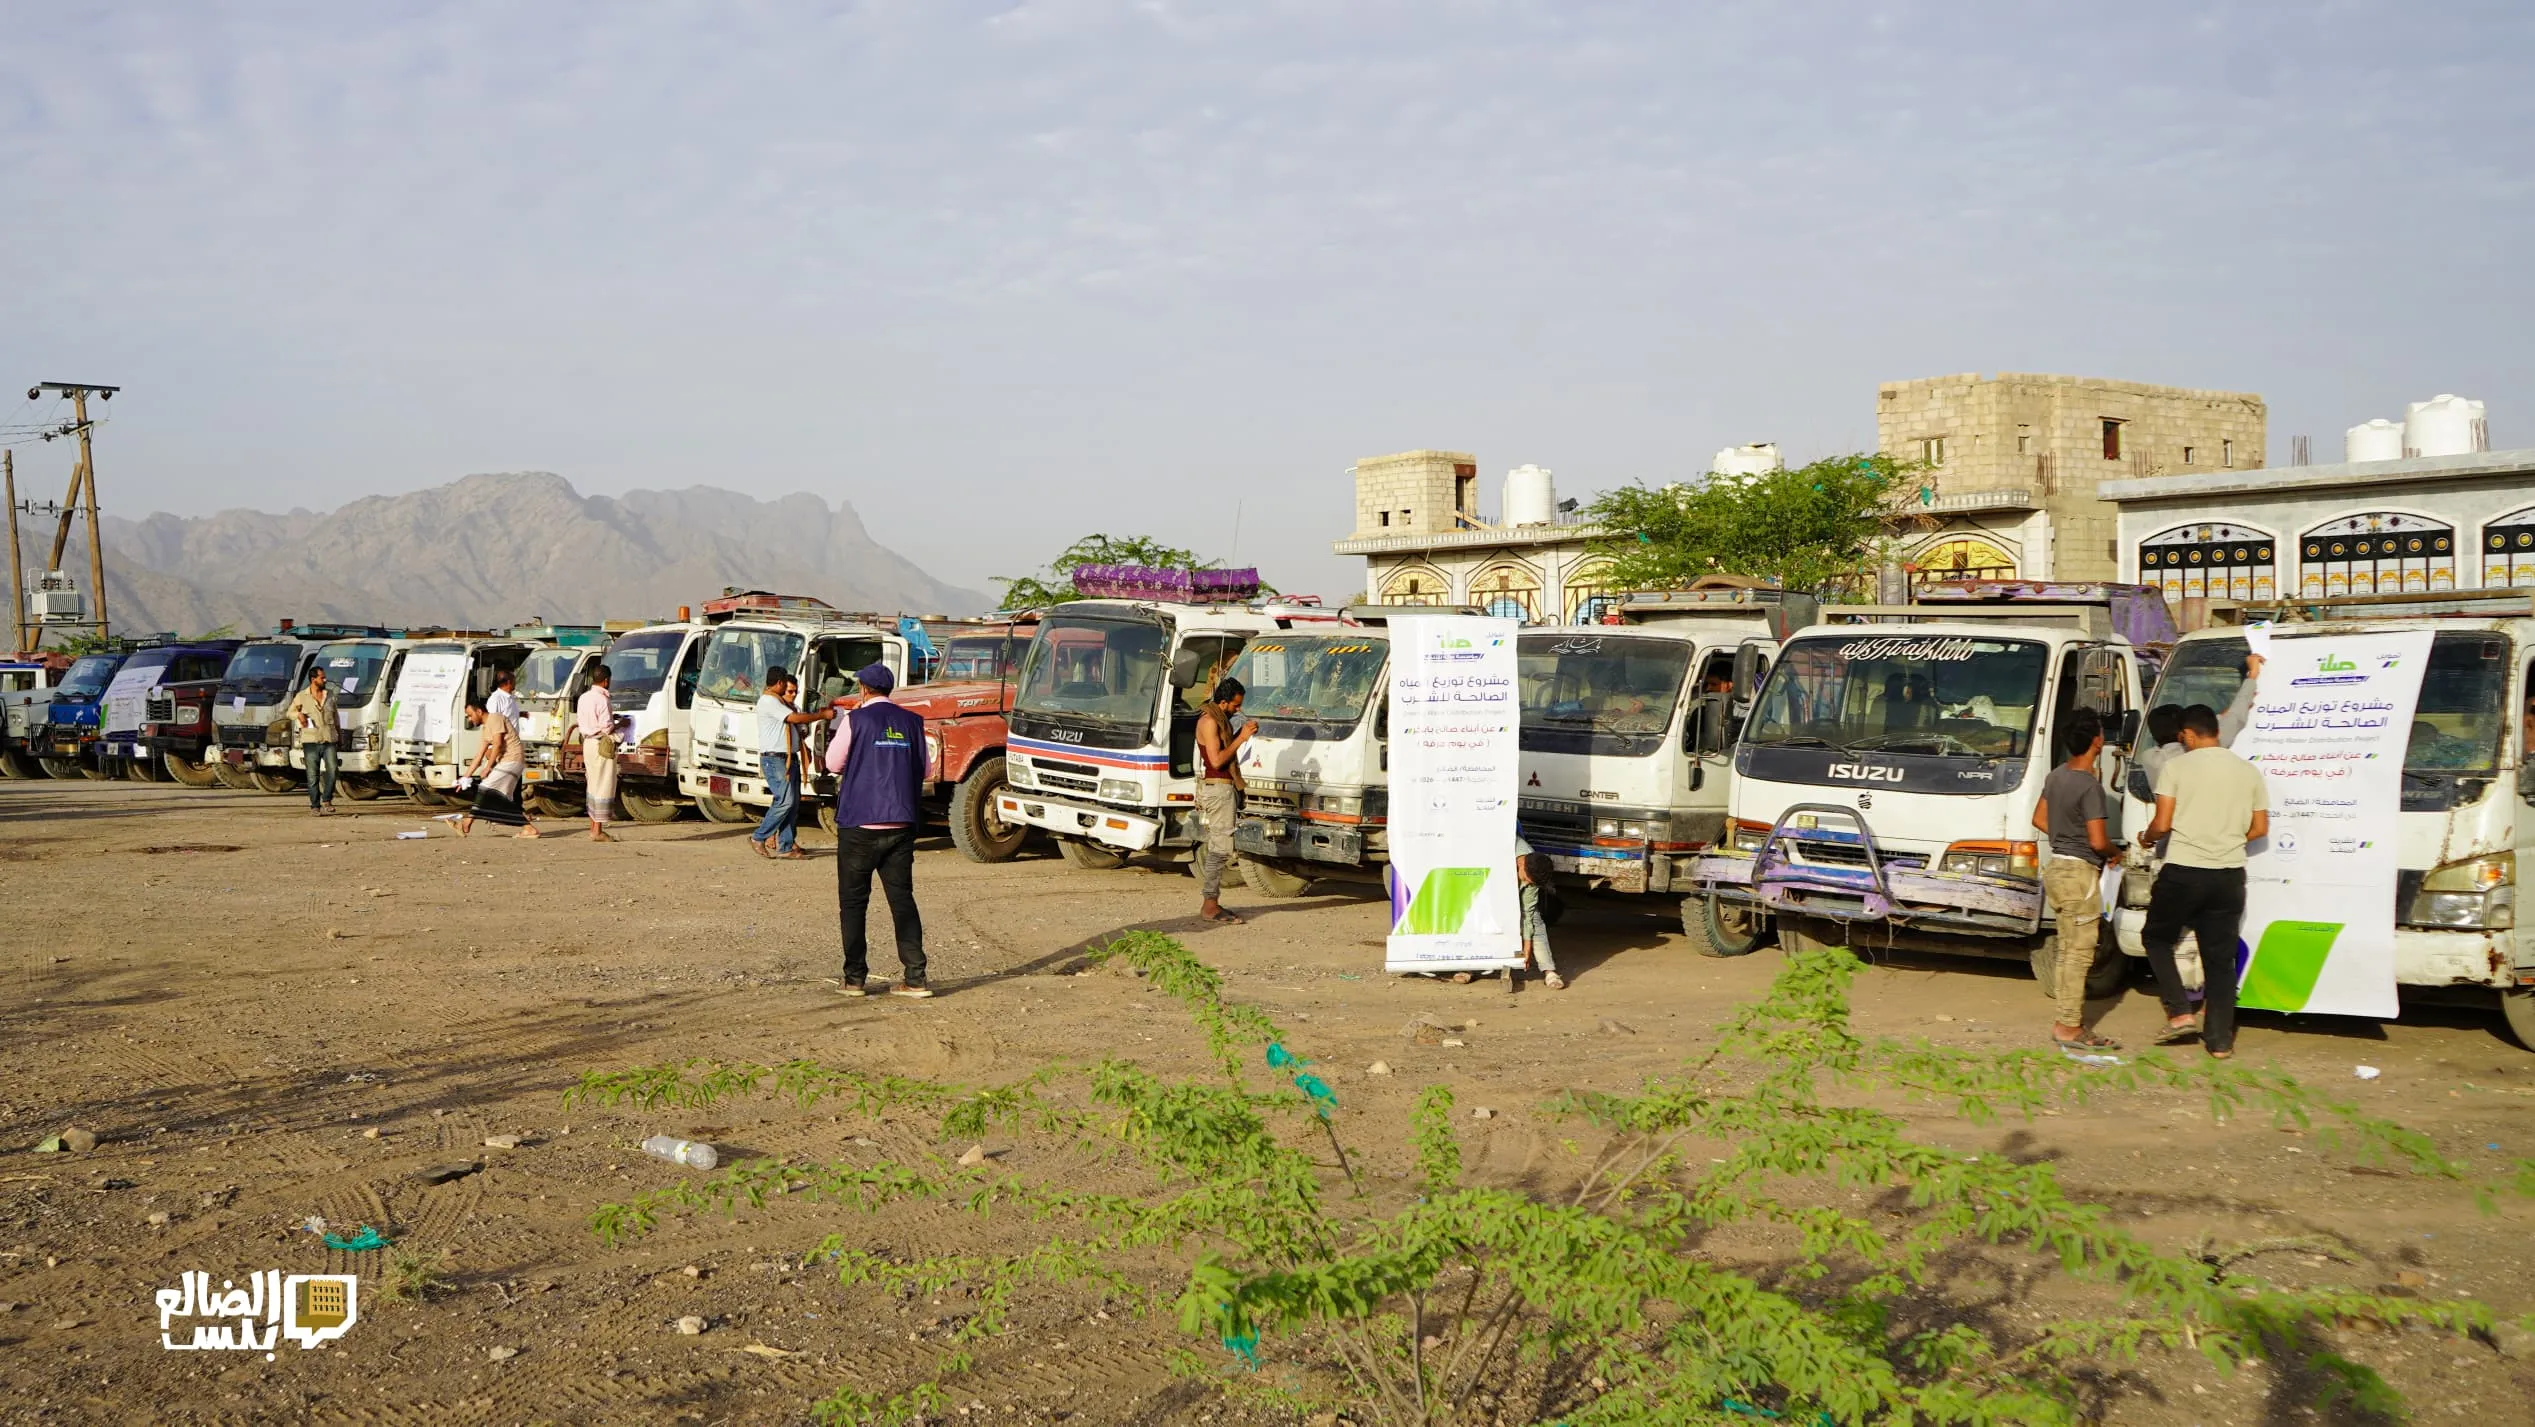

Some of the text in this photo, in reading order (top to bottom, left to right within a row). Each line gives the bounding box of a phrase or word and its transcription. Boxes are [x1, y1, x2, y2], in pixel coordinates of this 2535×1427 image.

[1432, 676, 1464, 689] توزيع
[1467, 673, 1510, 688] مشروع
[1453, 690, 1508, 702] الصالحة
[2256, 697, 2394, 715] مشروع توزيع المياه
[2255, 717, 2388, 732] الصالحة للشرب
[2344, 752, 2361, 760] عن
[1827, 763, 1905, 783] ISUZU
[1957, 771, 1993, 781] NPR
[1579, 789, 1620, 801] CANTER
[1519, 800, 1579, 814] UBISHI
